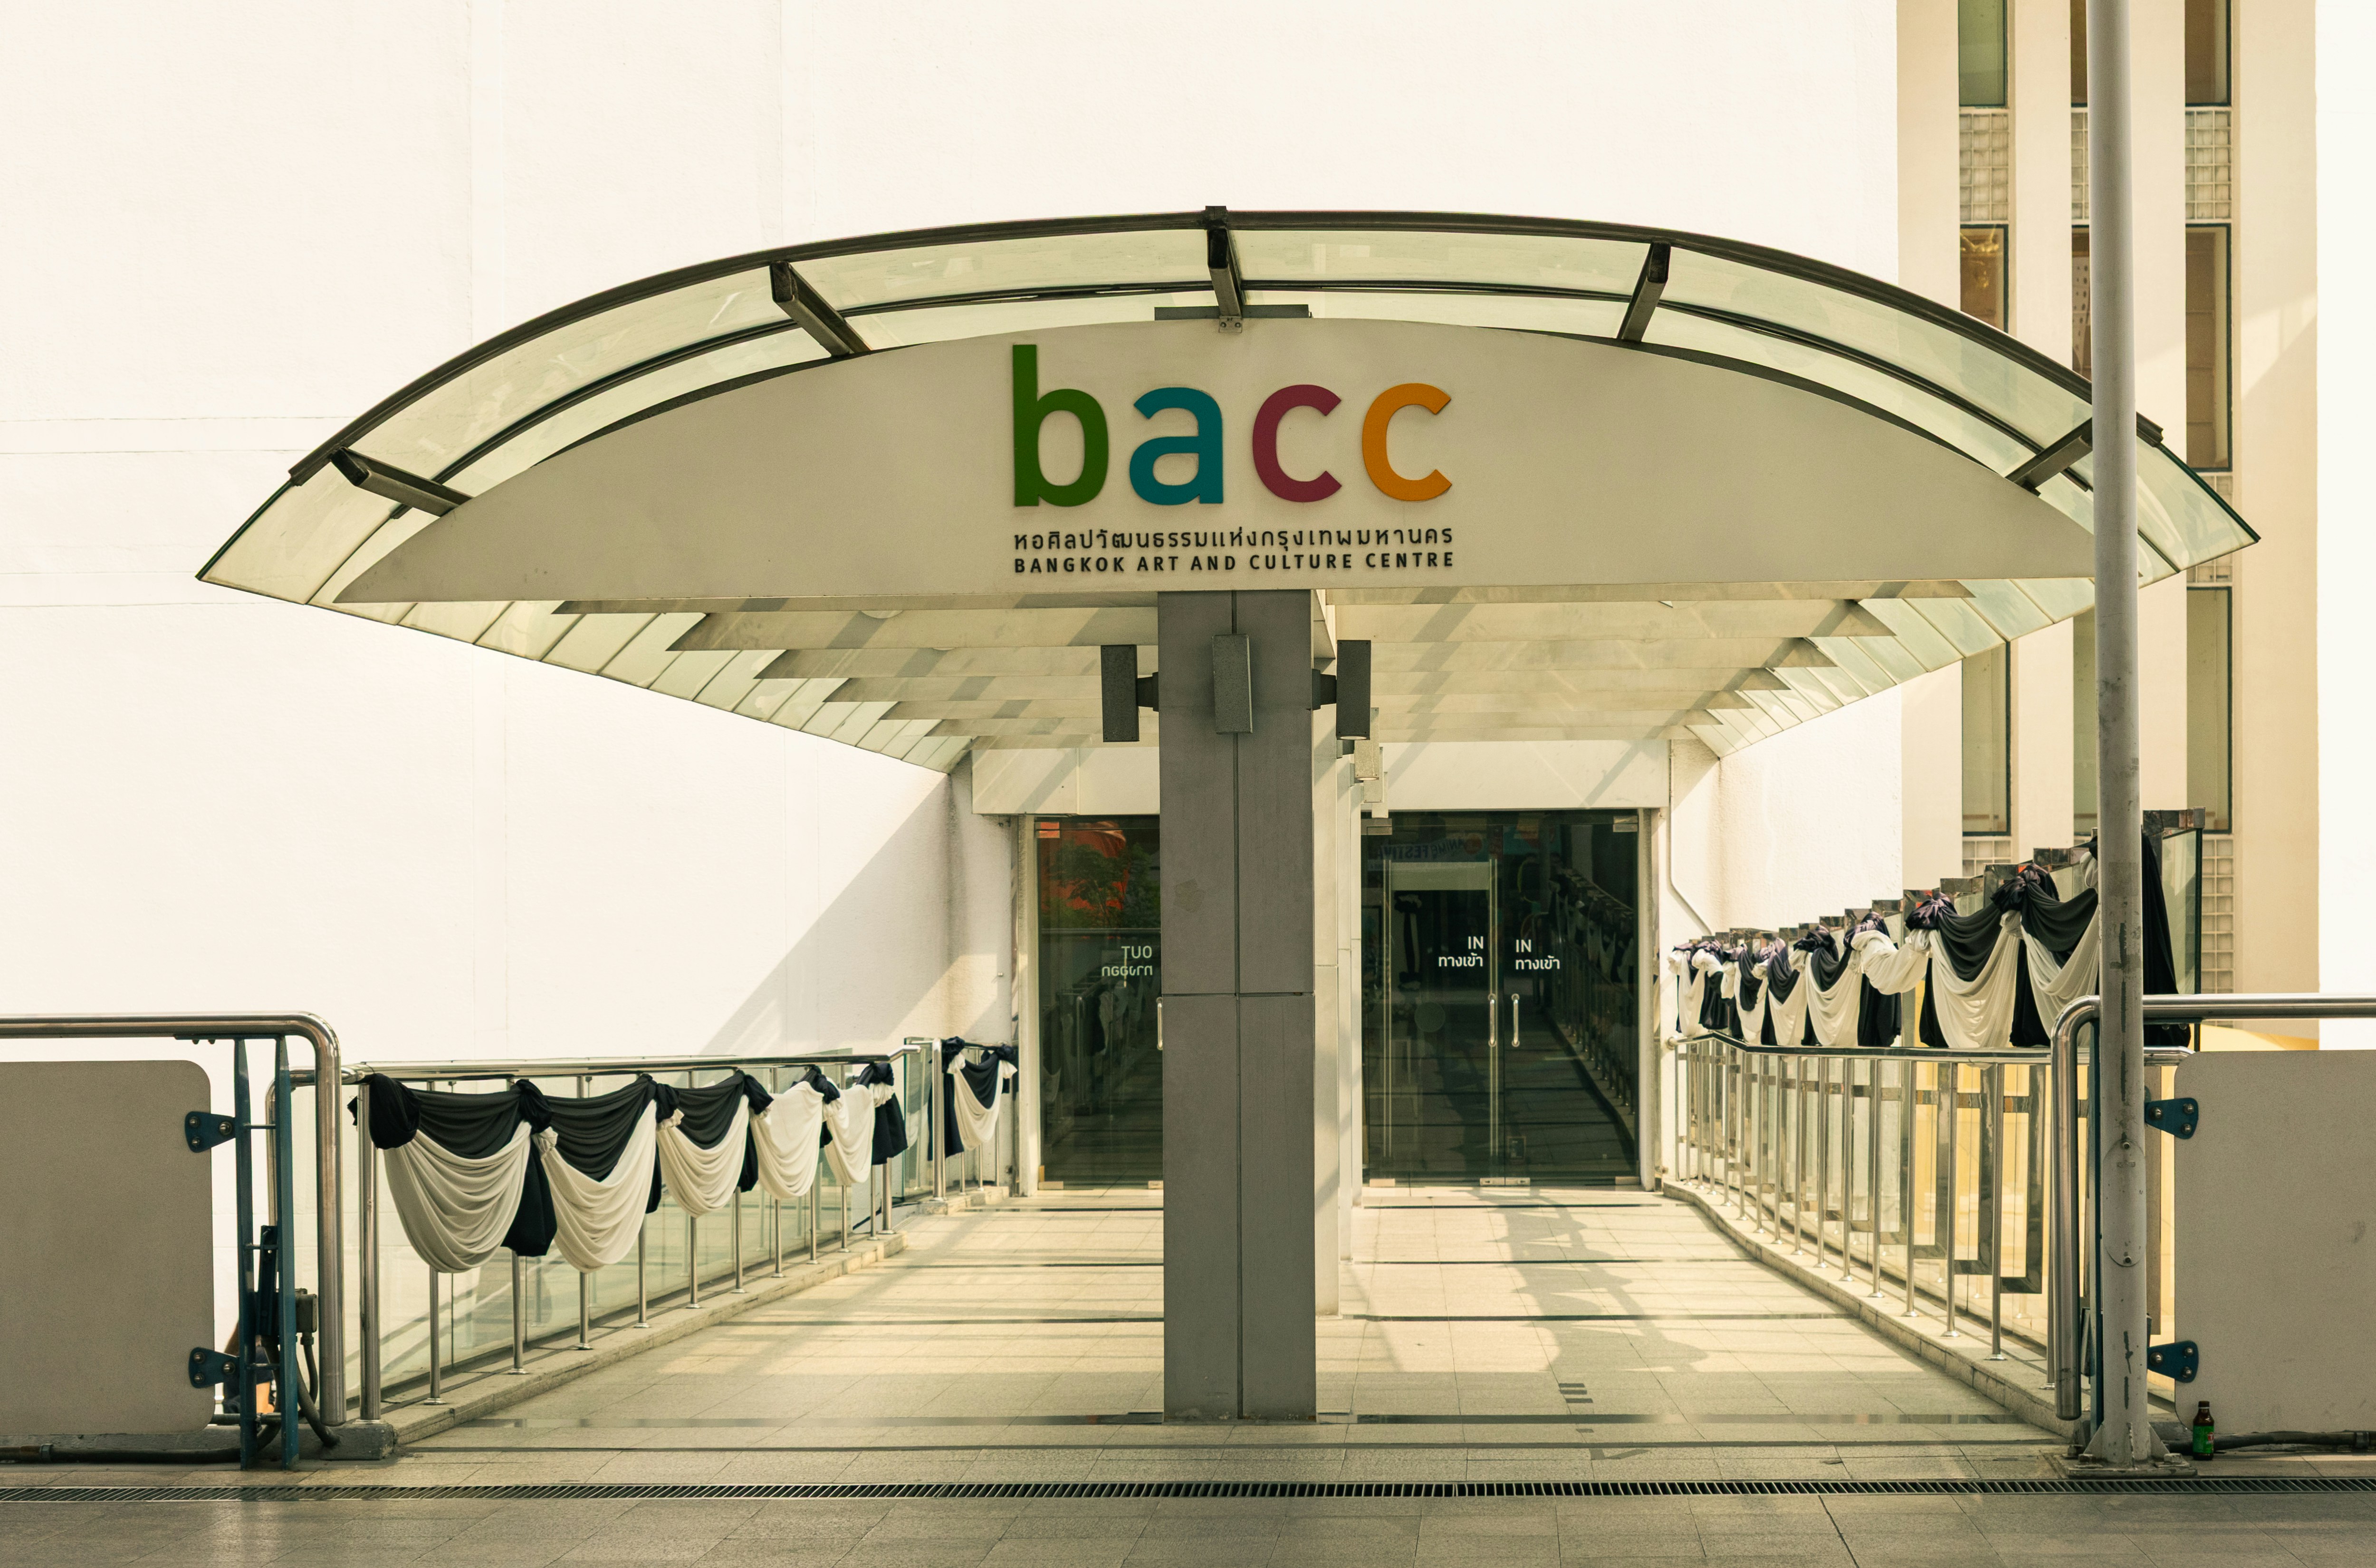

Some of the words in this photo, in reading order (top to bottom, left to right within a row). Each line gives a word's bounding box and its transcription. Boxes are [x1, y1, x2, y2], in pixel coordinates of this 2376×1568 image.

[1012, 344, 1453, 507] bacc
[1014, 526, 1453, 551] หอศิลปวัฒนธรรมแห่งกรุงเทพมหานคร
[1015, 557, 1125, 574] BANGKOK
[1137, 556, 1178, 572] ART
[1190, 555, 1236, 571] AND
[1249, 554, 1351, 570] CULTURE
[1365, 552, 1453, 568] CENTRE
[1468, 936, 1484, 949] IN
[1516, 939, 1532, 953] IN
[1438, 952, 1483, 967] ทางเข้า
[1515, 955, 1561, 970] ทางเข้า
